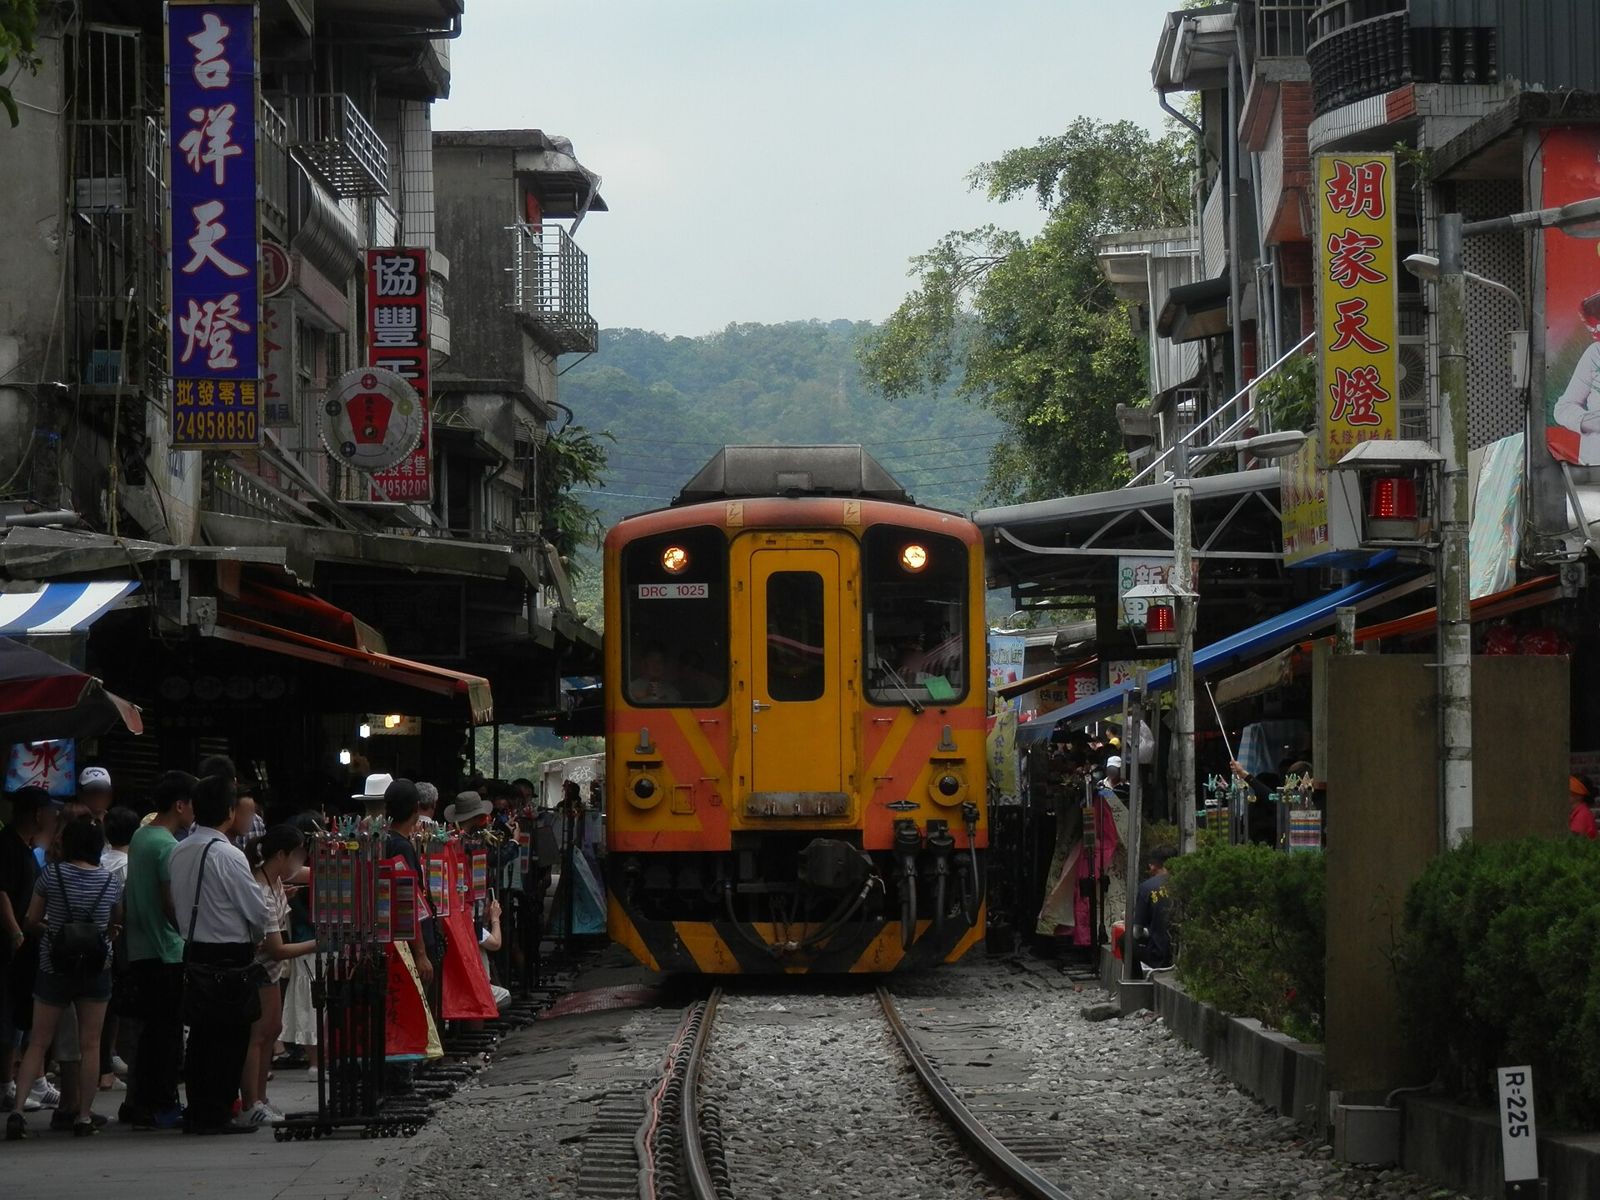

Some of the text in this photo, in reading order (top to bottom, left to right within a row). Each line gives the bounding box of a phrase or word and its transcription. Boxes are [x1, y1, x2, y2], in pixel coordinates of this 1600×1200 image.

[178, 12, 250, 371] 吉祥天燈
[1326, 160, 1391, 426] 胡家天燈
[176, 381, 256, 406] 批發零售
[176, 411, 256, 440] 24958850
[641, 585, 705, 597] DRC 1025
[1505, 1071, 1530, 1138] R=225
